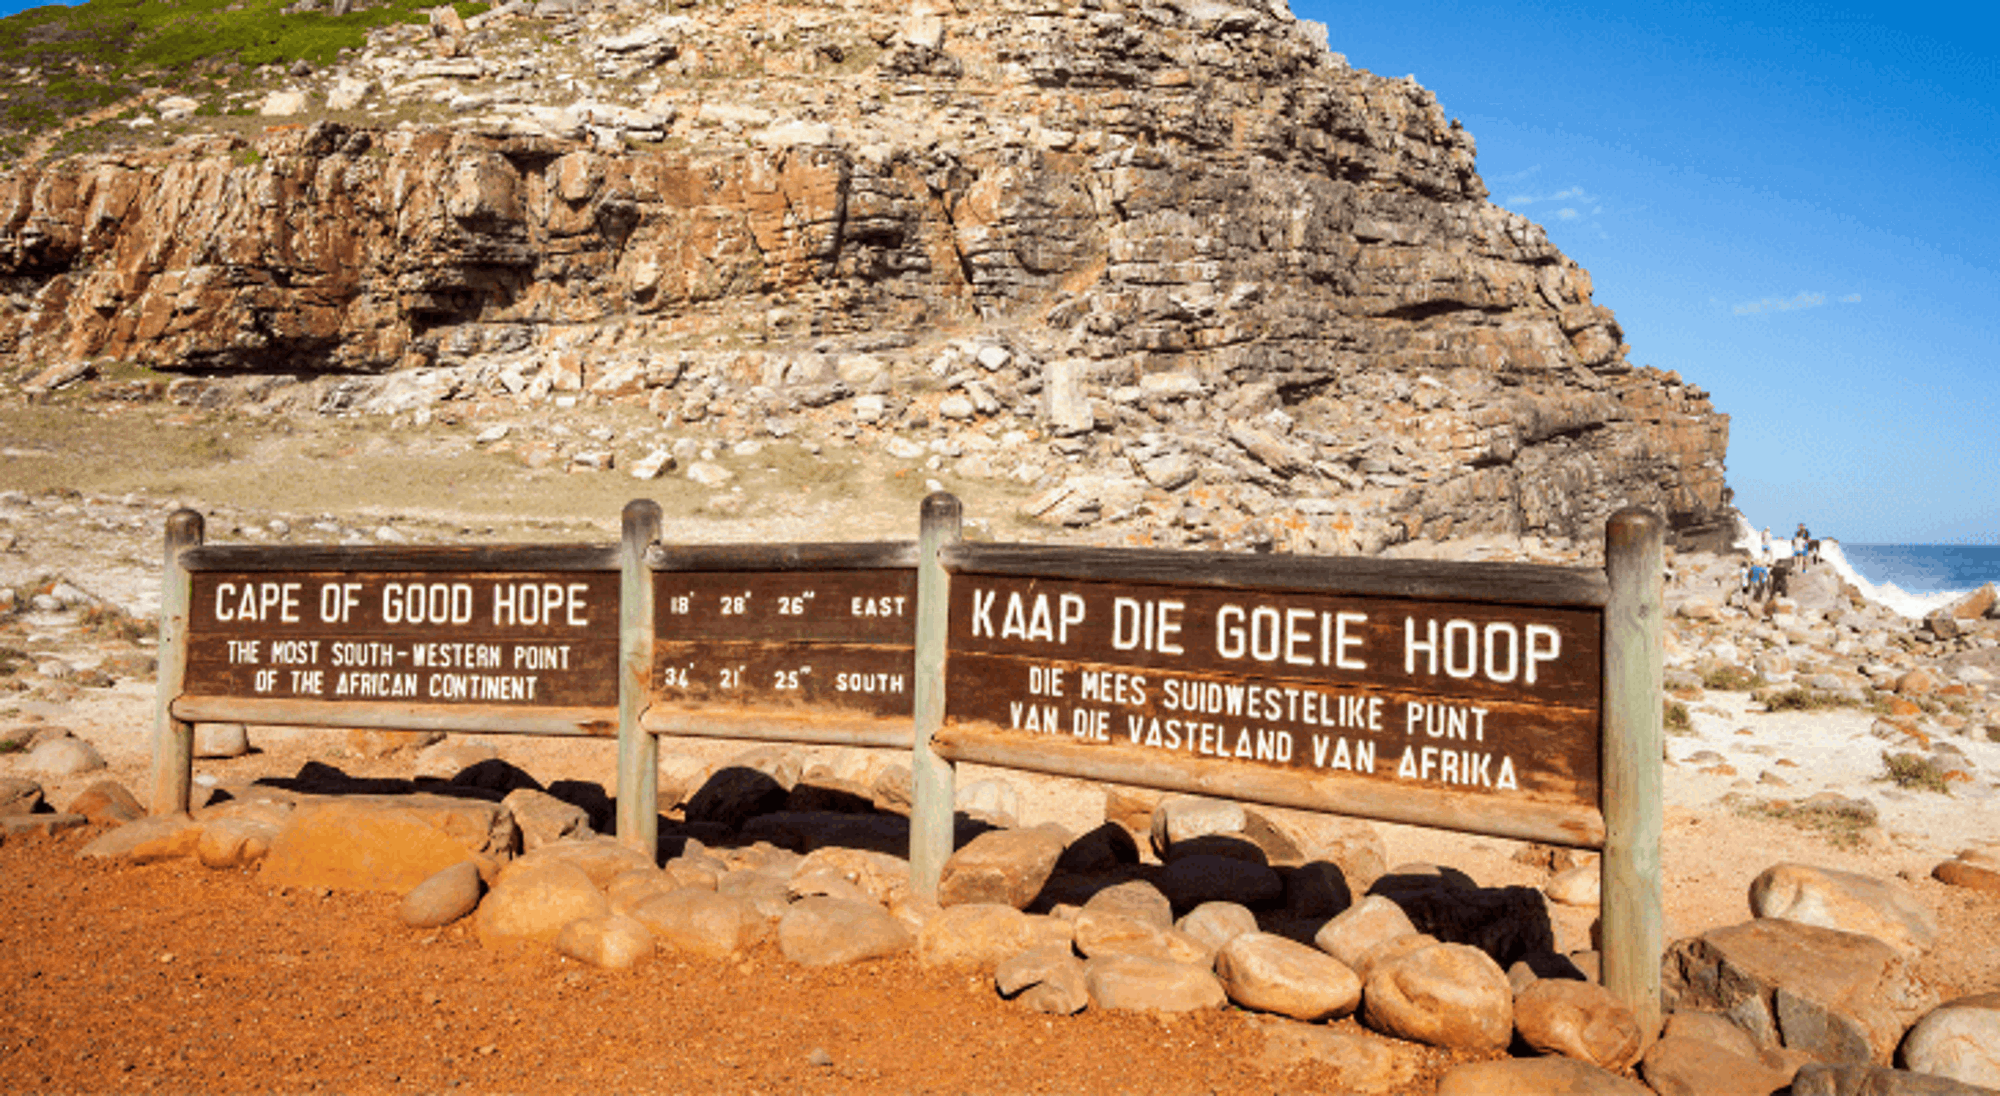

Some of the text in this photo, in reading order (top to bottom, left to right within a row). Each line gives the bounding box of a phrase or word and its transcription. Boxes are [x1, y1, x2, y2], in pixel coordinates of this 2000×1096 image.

[215, 583, 589, 626] CAPE OF GOOD HOPE
[851, 596, 905, 617] EAST
[227, 640, 571, 670] THE MOST SOUTH-WESTERN POINT
[972, 589, 1561, 684] KAAP DIE GOEIE HOOP
[254, 669, 538, 700] OF THE AFRICAN CONTINENT
[835, 672, 904, 693] SOUTH
[1029, 665, 1489, 742] DIE MEES SUIDWESTELIKE PUNT
[1010, 701, 1519, 791] VAN DIE VASTELAND VAN AFRIKA
